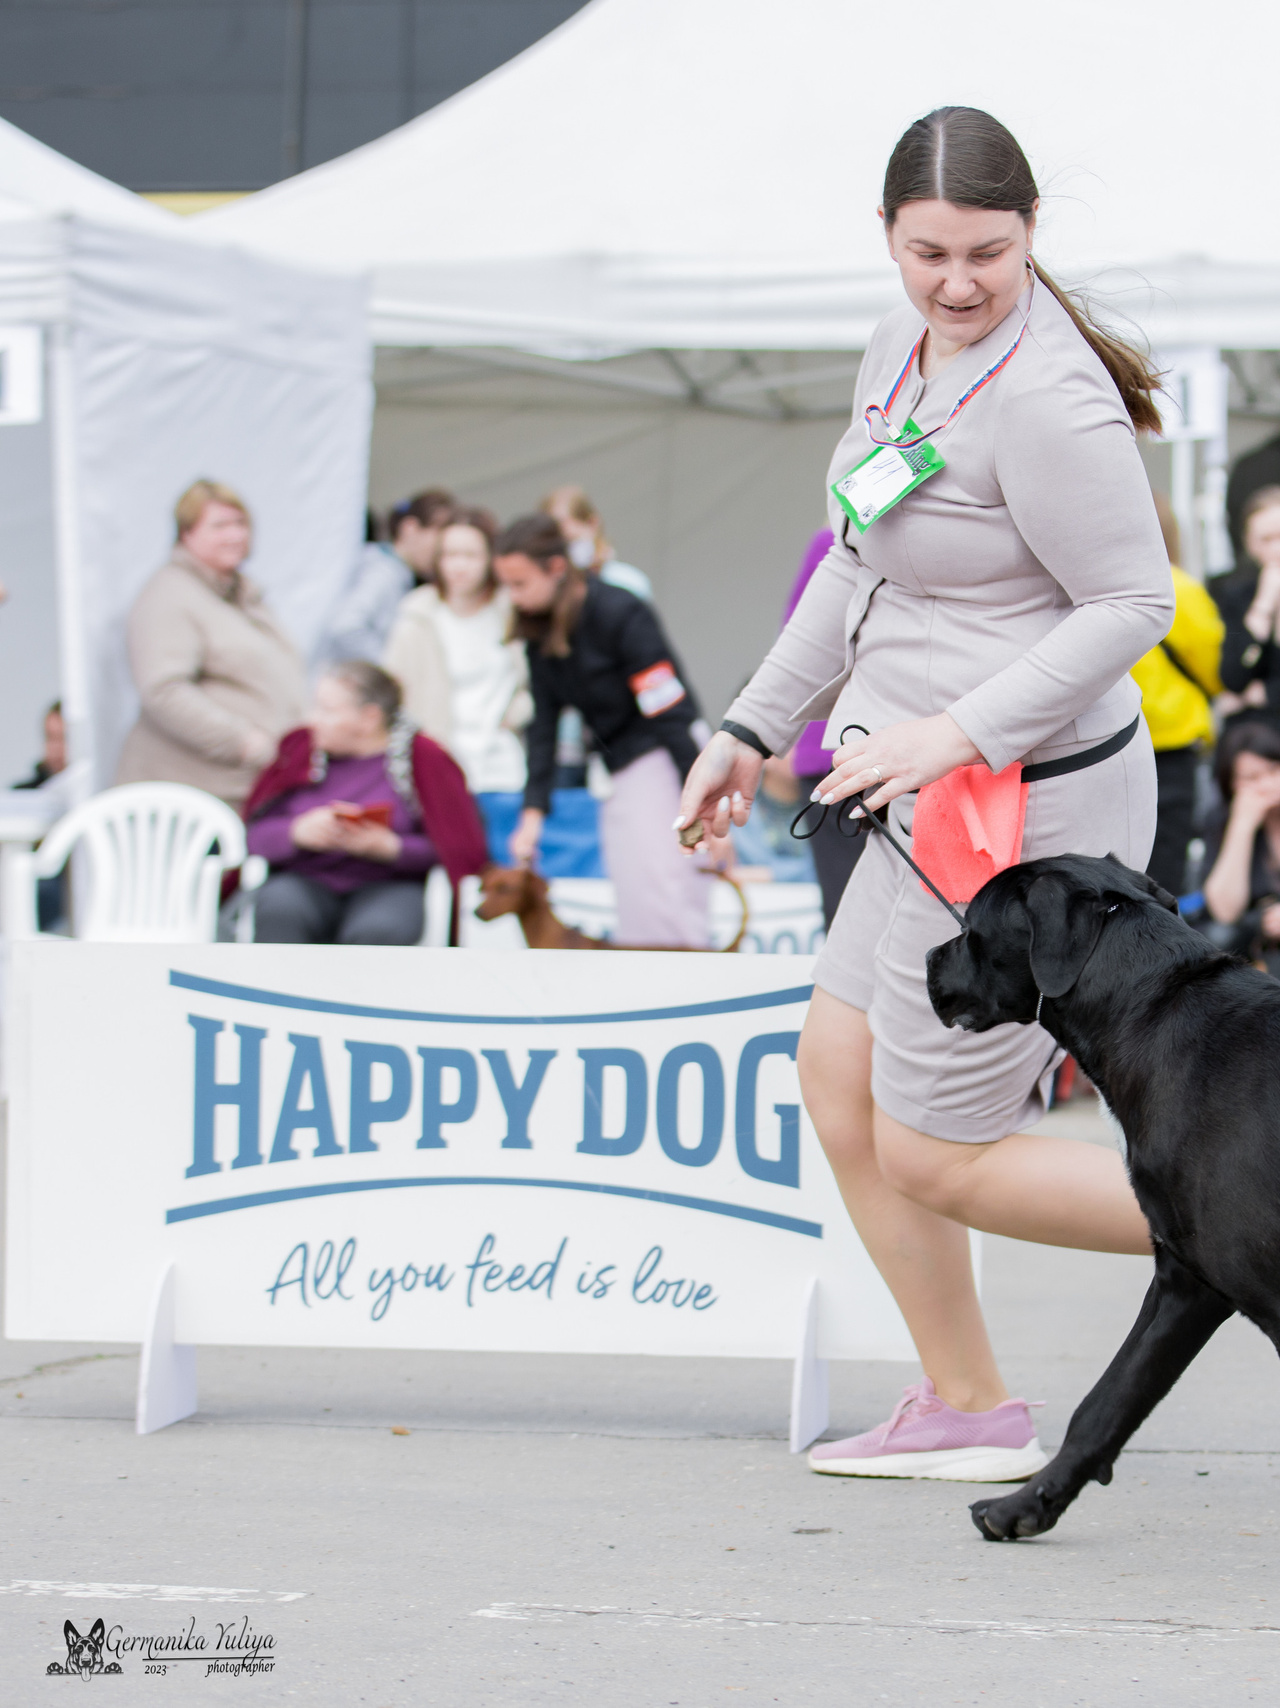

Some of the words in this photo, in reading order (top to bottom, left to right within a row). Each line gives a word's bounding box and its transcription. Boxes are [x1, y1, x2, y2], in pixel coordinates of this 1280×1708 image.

[184, 1013, 558, 1180] HAPPY
[576, 1030, 801, 1190] DOG
[265, 1236, 356, 1307] All
[367, 1261, 455, 1322] you
[465, 1233, 569, 1307] feed
[576, 1260, 618, 1300] is
[631, 1245, 719, 1311] love
